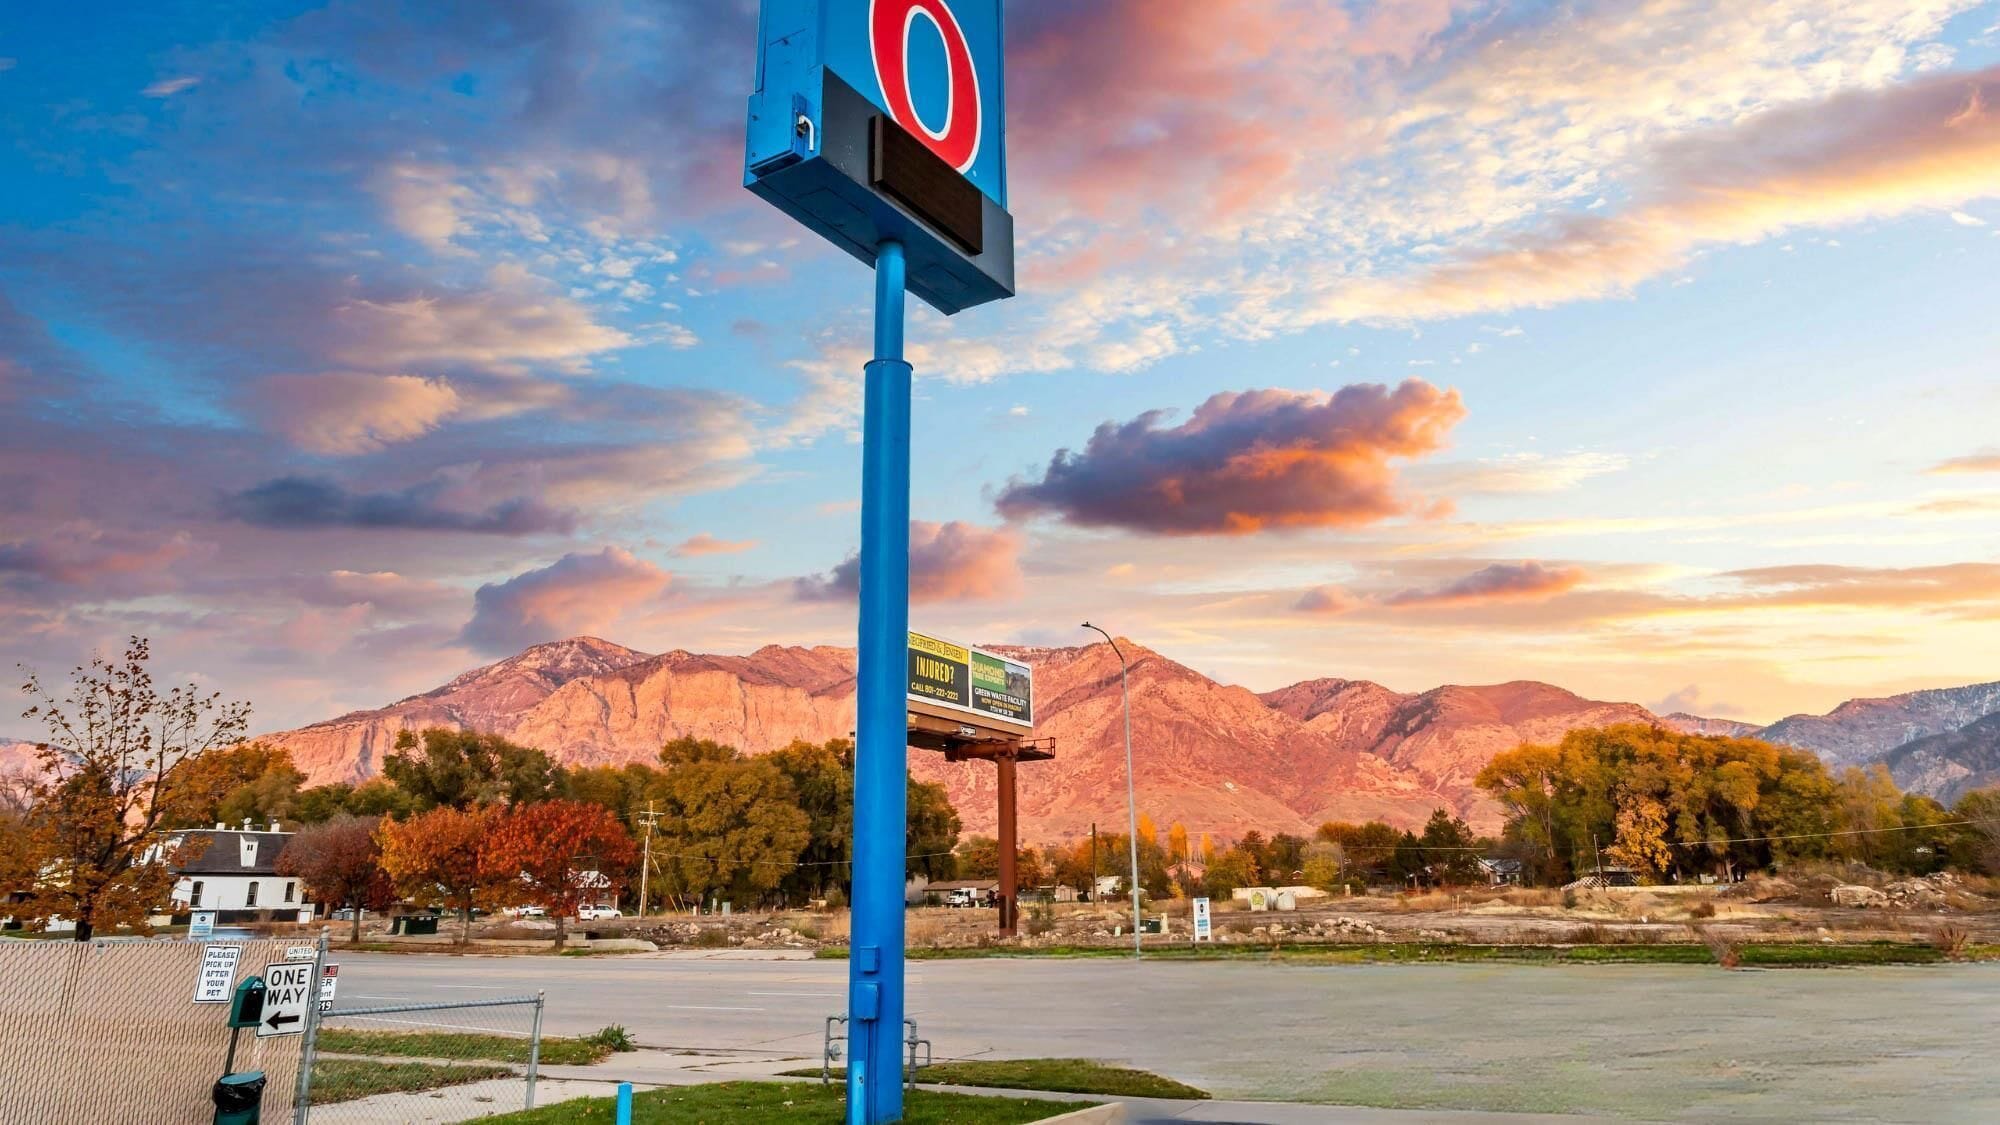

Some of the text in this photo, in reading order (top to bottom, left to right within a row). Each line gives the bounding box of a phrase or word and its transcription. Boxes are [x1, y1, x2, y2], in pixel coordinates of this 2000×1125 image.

[916, 655, 955, 685] INJURED?
[911, 682, 924, 692] CALL
[974, 687, 1027, 707] GREEN WASTE FACILITY
[208, 951, 236, 959] PLEASE
[205, 970, 229, 978] AFTER
[270, 968, 308, 986] ONE
[267, 987, 306, 1006] WAY
